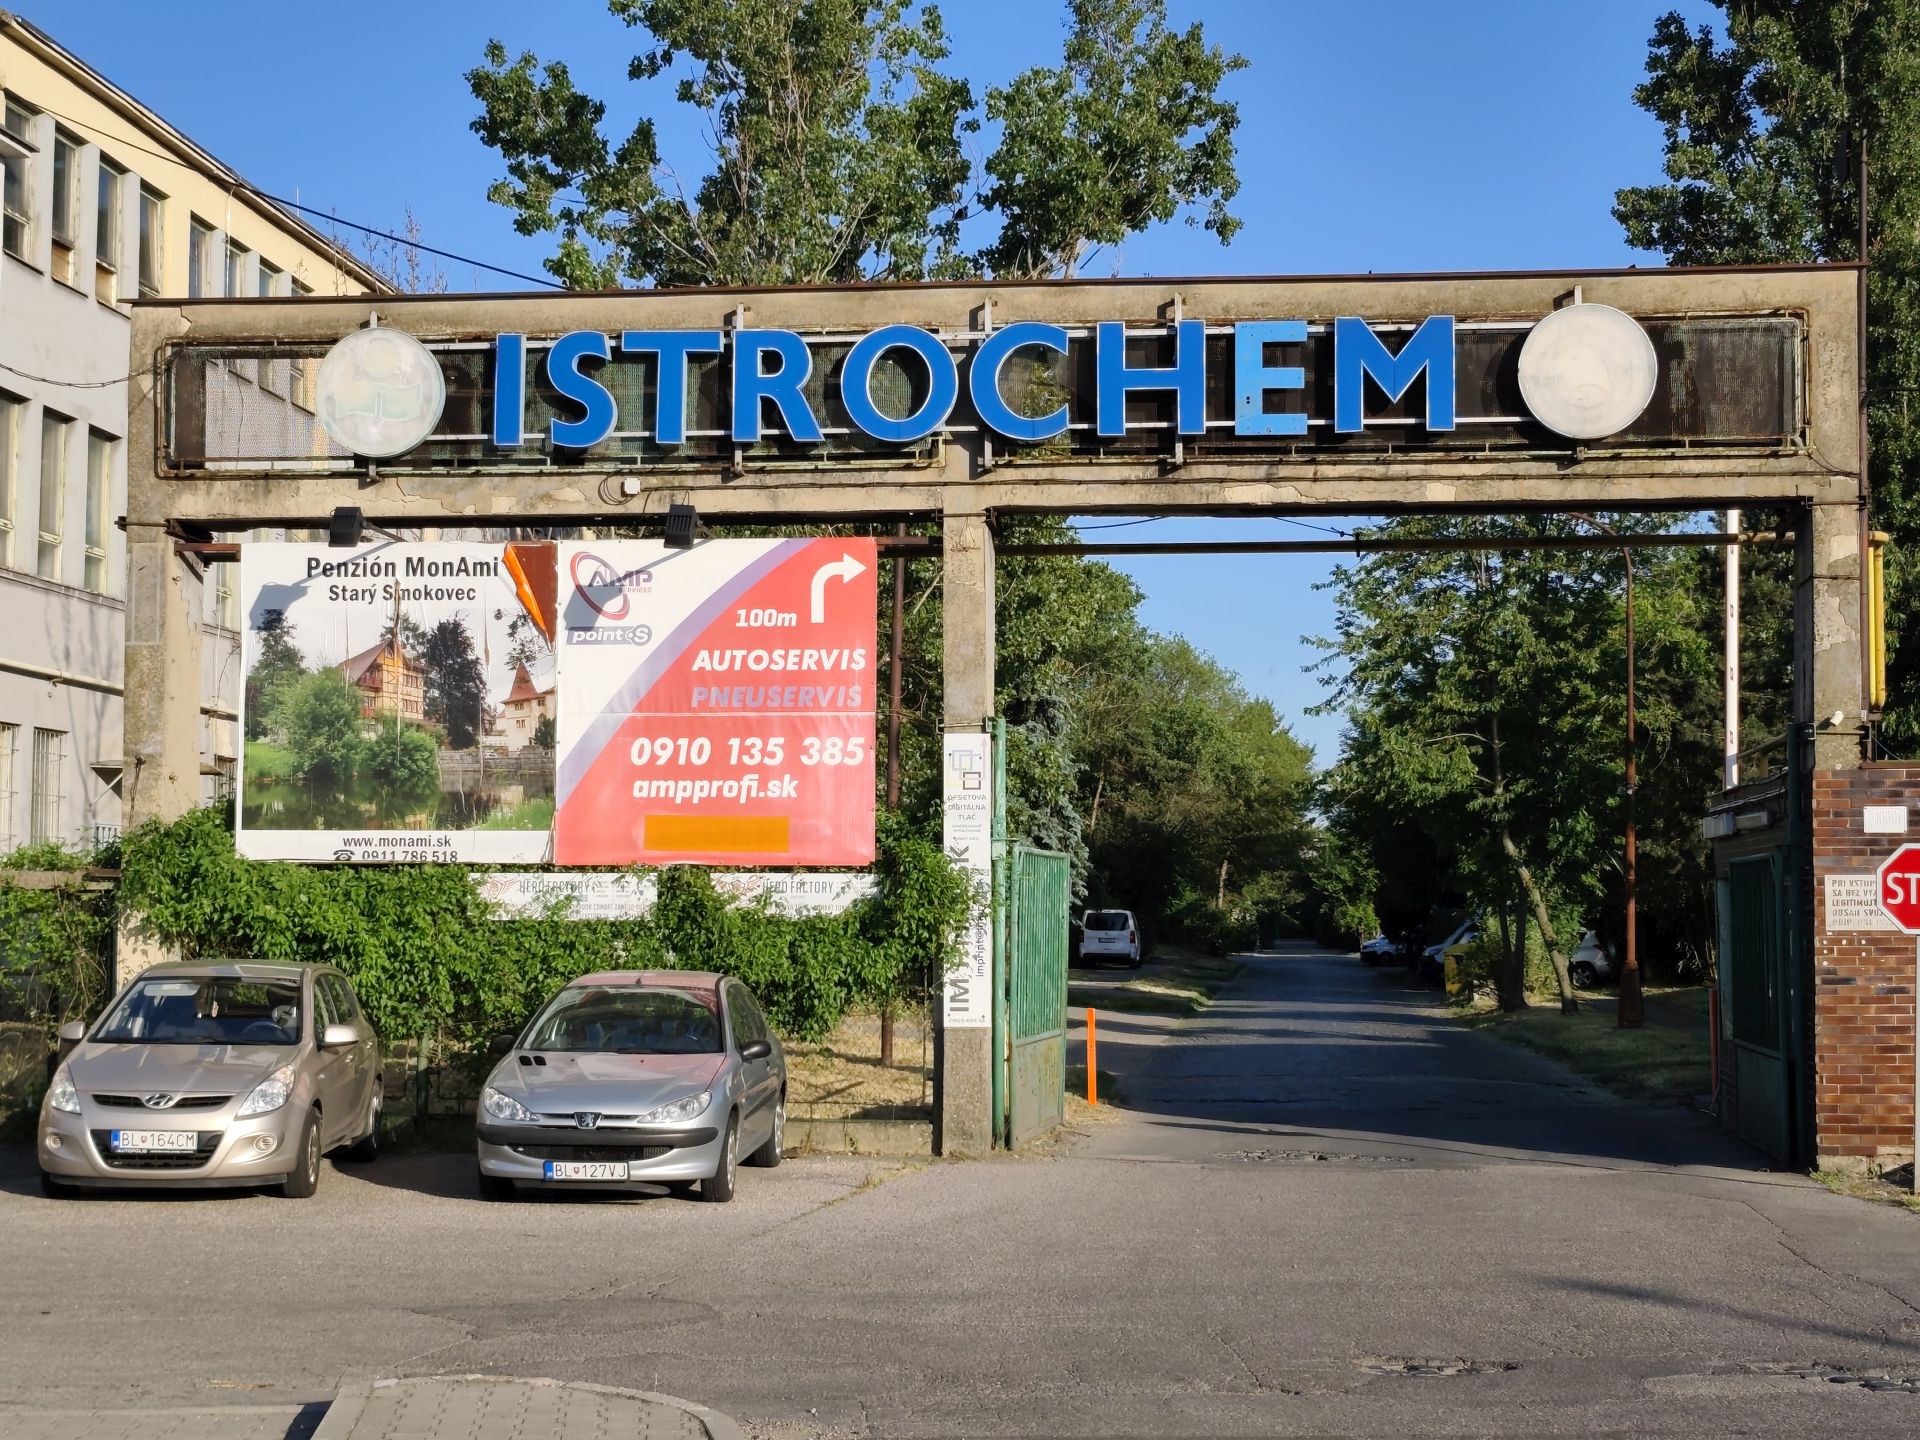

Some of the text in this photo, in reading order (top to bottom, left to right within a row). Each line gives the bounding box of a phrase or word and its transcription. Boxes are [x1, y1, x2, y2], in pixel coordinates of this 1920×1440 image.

[493, 314, 1456, 449] ISTROCHEM
[307, 556, 499, 578] Penzión MonAmi
[587, 570, 653, 587] AMP
[329, 583, 477, 605] Starý Smokovec
[735, 608, 798, 628] 100m
[572, 628, 624, 644] point
[691, 648, 867, 672] AUTOSERVIS
[691, 686, 863, 709] PNEUSERVIS
[630, 737, 866, 766] 0910 135 385
[633, 773, 799, 804] ampprofi.sk
[342, 834, 452, 848] www.monami.sk
[361, 850, 459, 863] 0911 786 518
[519, 880, 544, 893] HERO
[762, 881, 834, 894] HERO FACTORY
[1832, 889, 1842, 897] SA
[1832, 898, 1878, 907] LEGITIMUJT
[121, 1132, 140, 1147] BL
[149, 1133, 195, 1147] 164CM
[555, 1164, 572, 1178] BL
[582, 1164, 626, 1178] 127VJ
